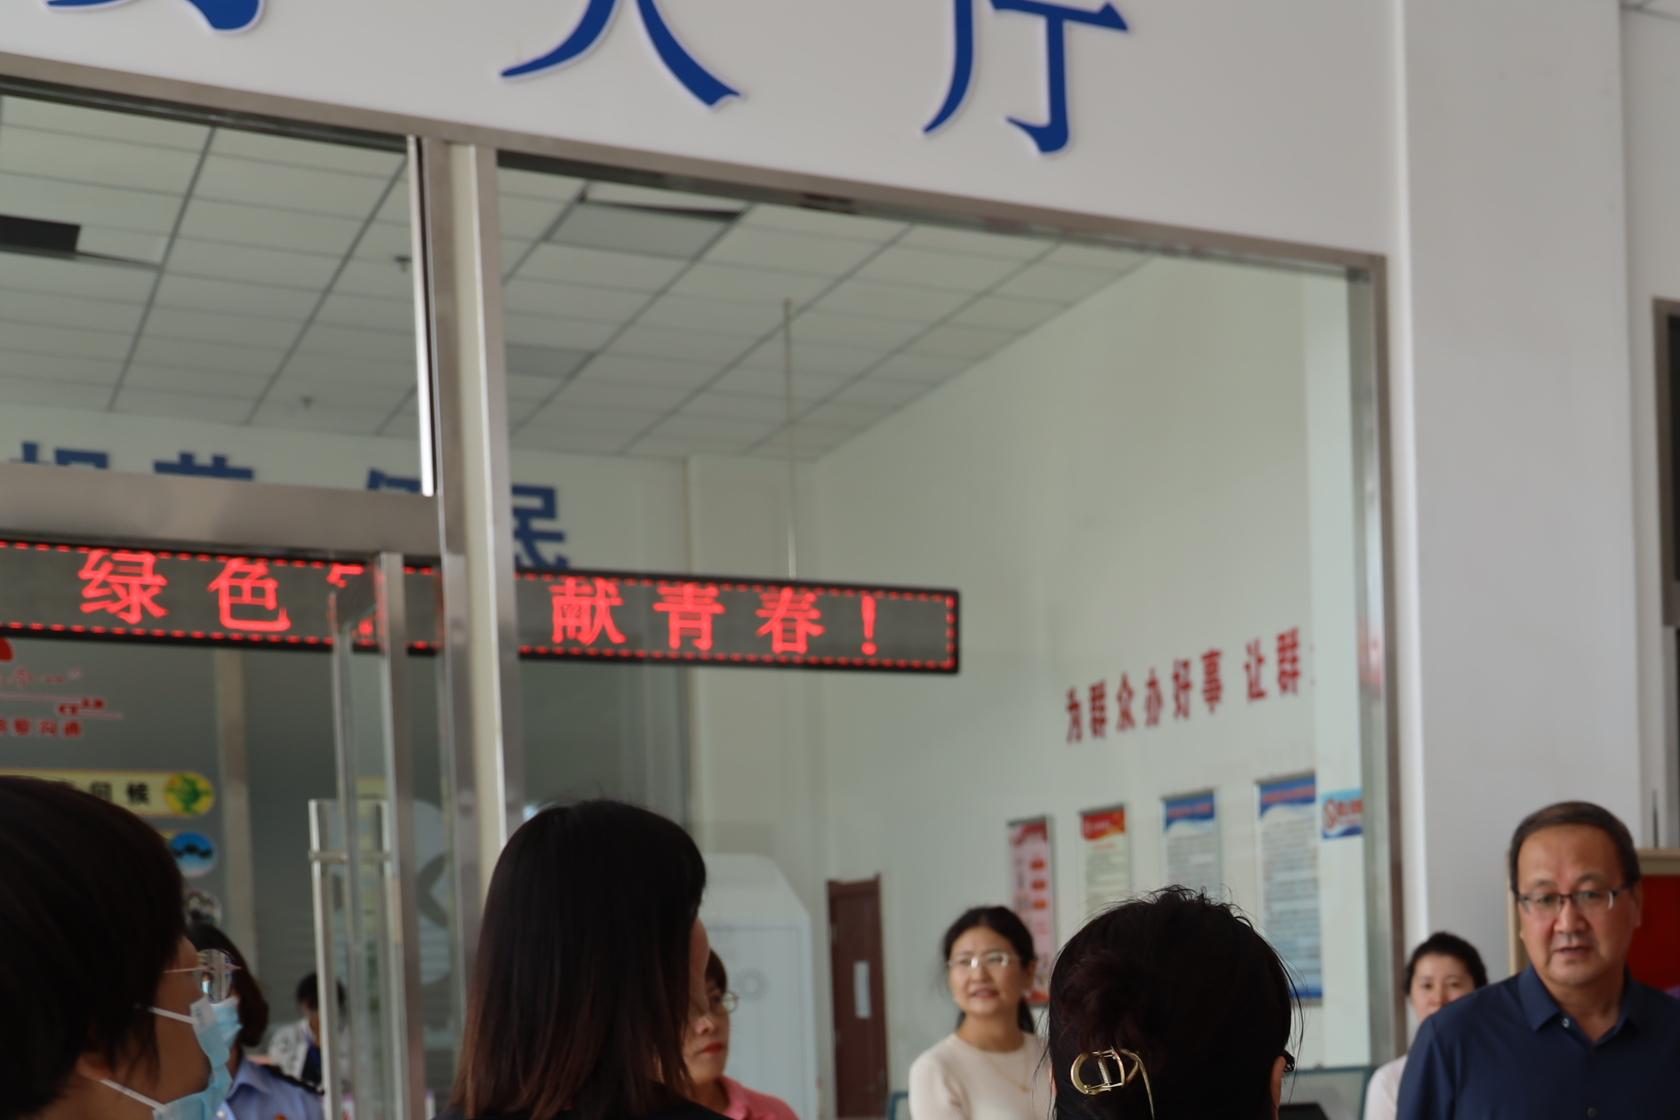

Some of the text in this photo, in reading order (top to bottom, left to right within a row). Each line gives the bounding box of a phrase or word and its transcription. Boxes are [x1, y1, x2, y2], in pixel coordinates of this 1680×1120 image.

[1066, 648, 1222, 745] 为群众办好事
